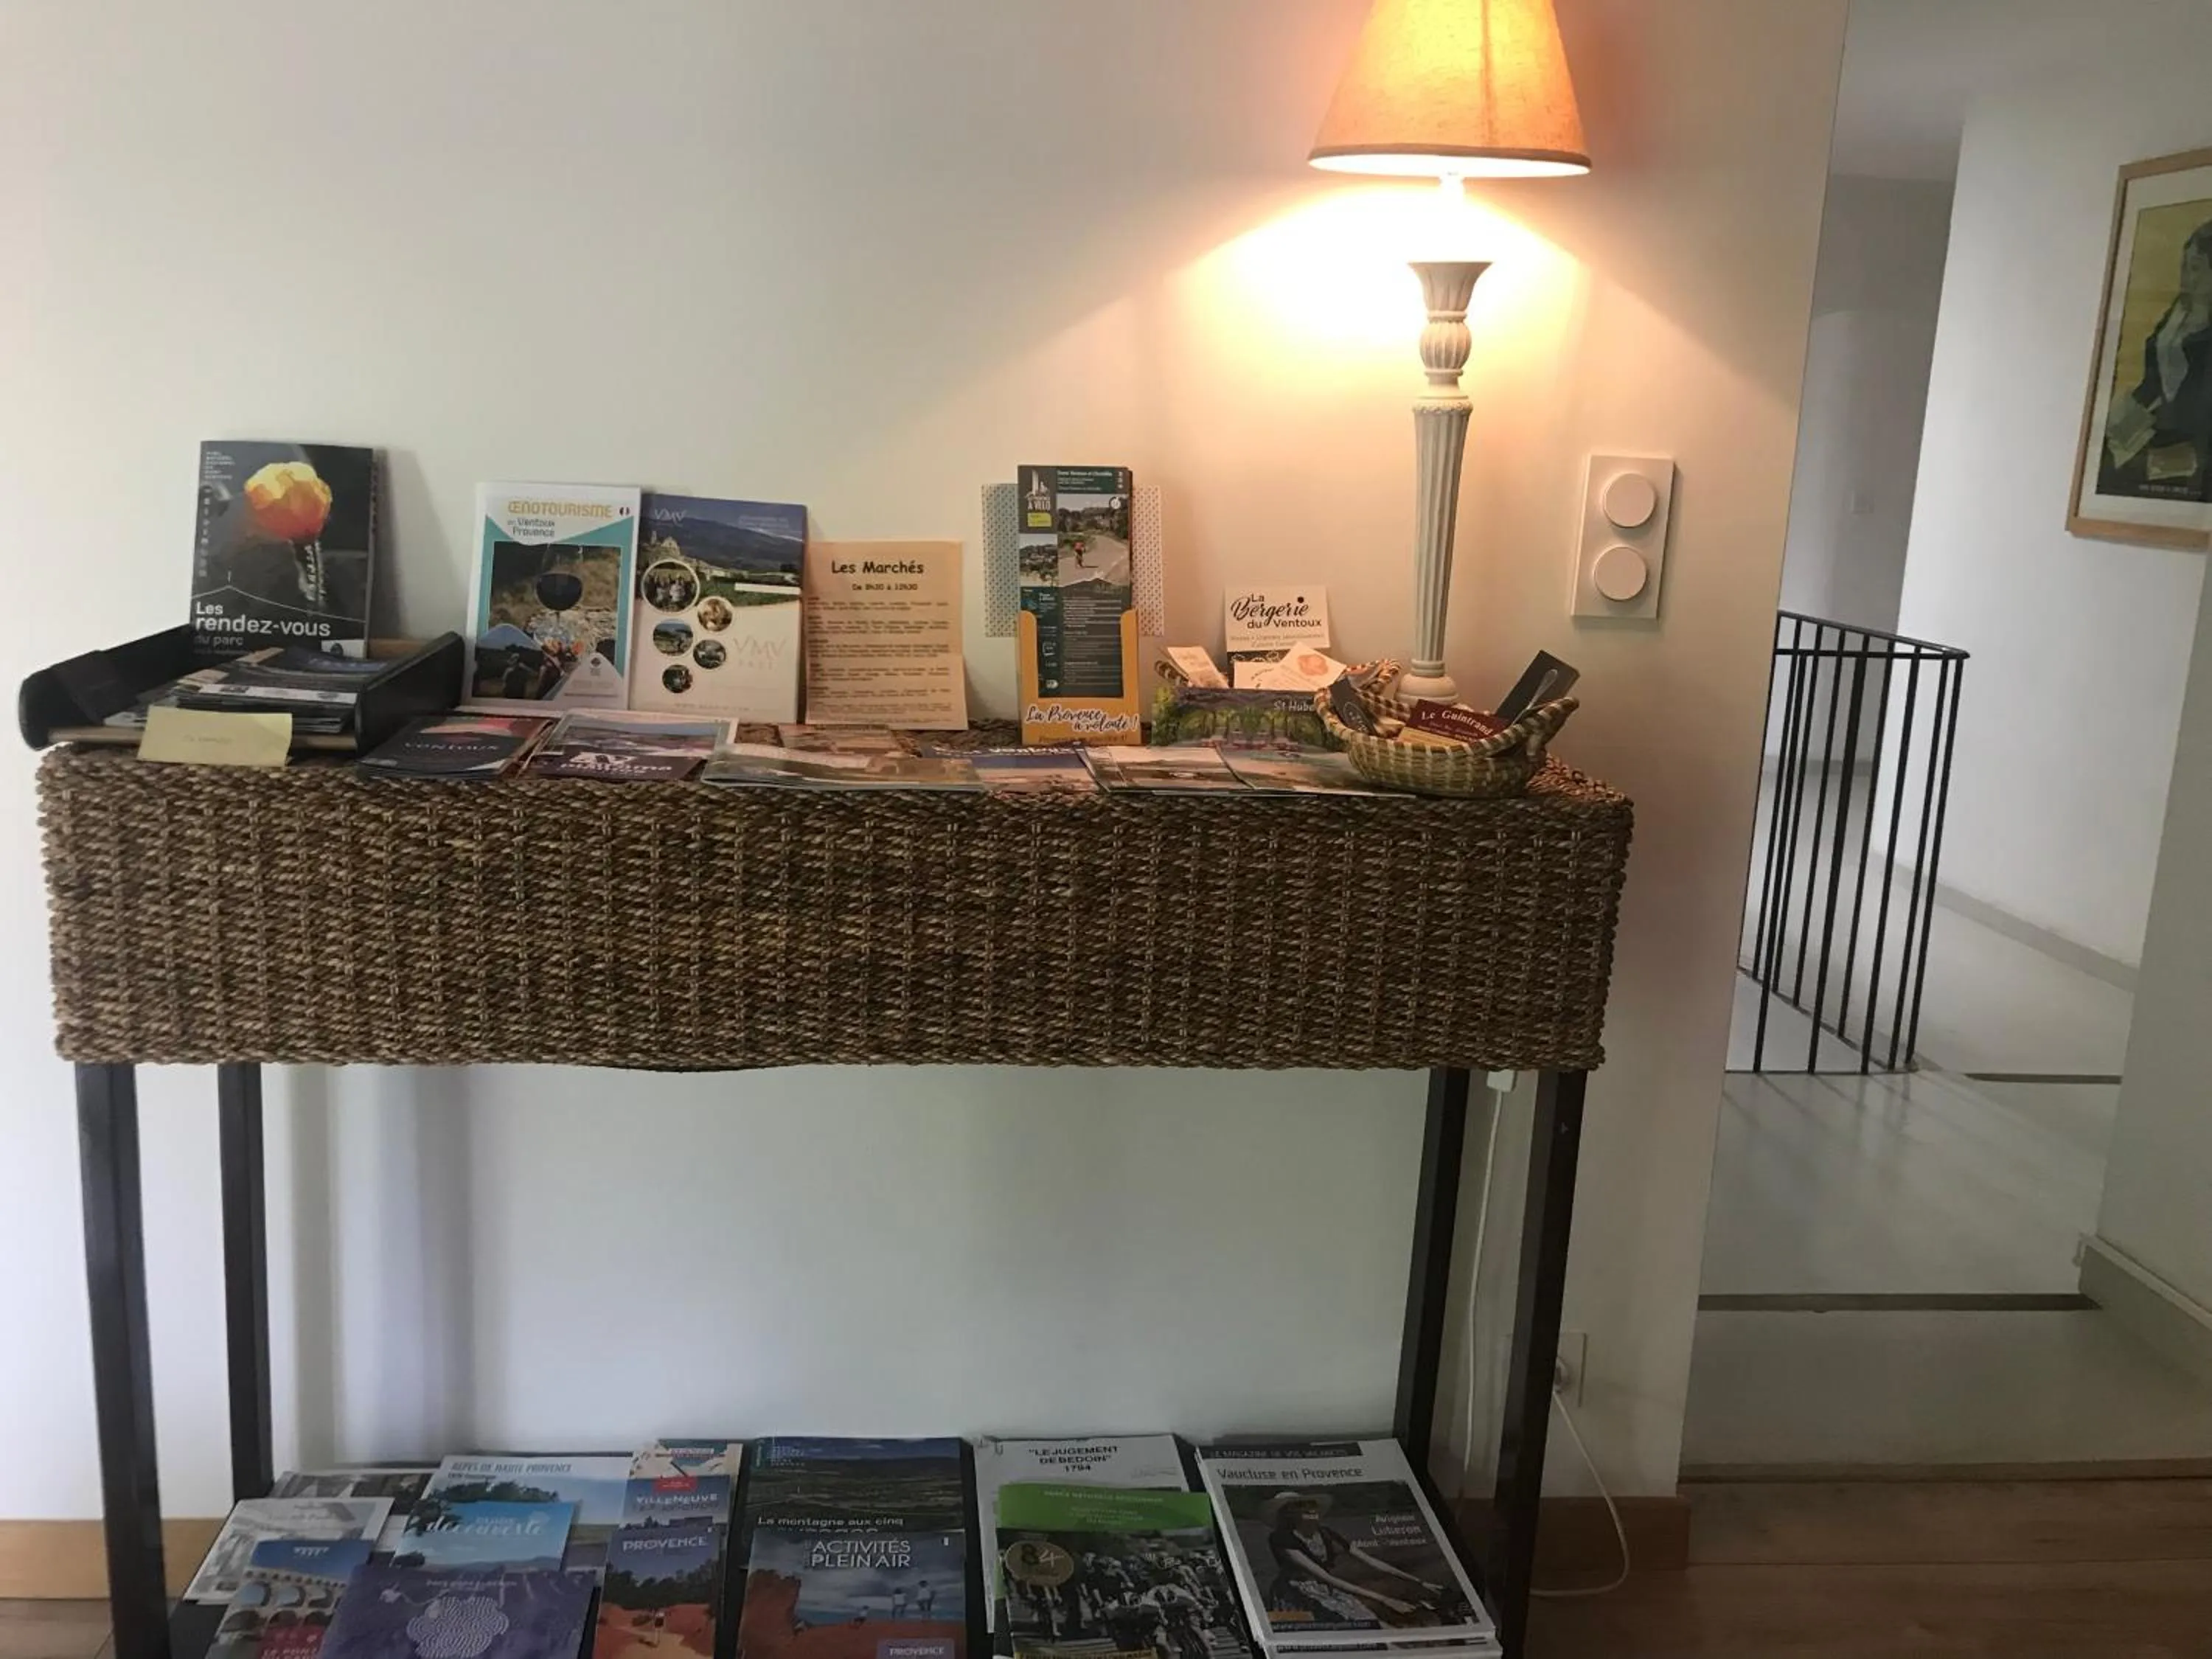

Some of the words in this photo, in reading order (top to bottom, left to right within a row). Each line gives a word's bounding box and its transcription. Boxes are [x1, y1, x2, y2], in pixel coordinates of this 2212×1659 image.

[831, 560, 855, 574] Les
[862, 560, 924, 574] Marchés
[1251, 593, 1265, 602] La
[195, 601, 223, 614] Les
[1230, 594, 1310, 627] Bergerie
[195, 613, 331, 636] rendez-vous
[1247, 620, 1263, 629] du
[1273, 619, 1322, 628] Ventoux
[212, 636, 244, 647] parc
[1047, 704, 1103, 722] Provence
[1421, 711, 1436, 720] Le
[1441, 709, 1494, 736] Guintrand
[1280, 1470, 1298, 1479] en
[1301, 1467, 1364, 1479] Provence
[757, 1516, 775, 1526] La
[778, 1517, 844, 1527] montagne
[875, 1517, 903, 1527] cinq
[622, 1535, 709, 1552] PROVENCE
[813, 1537, 911, 1554] ACTIVITÉS
[811, 1554, 871, 1568] PLEIN
[875, 1554, 911, 1568] AIR
